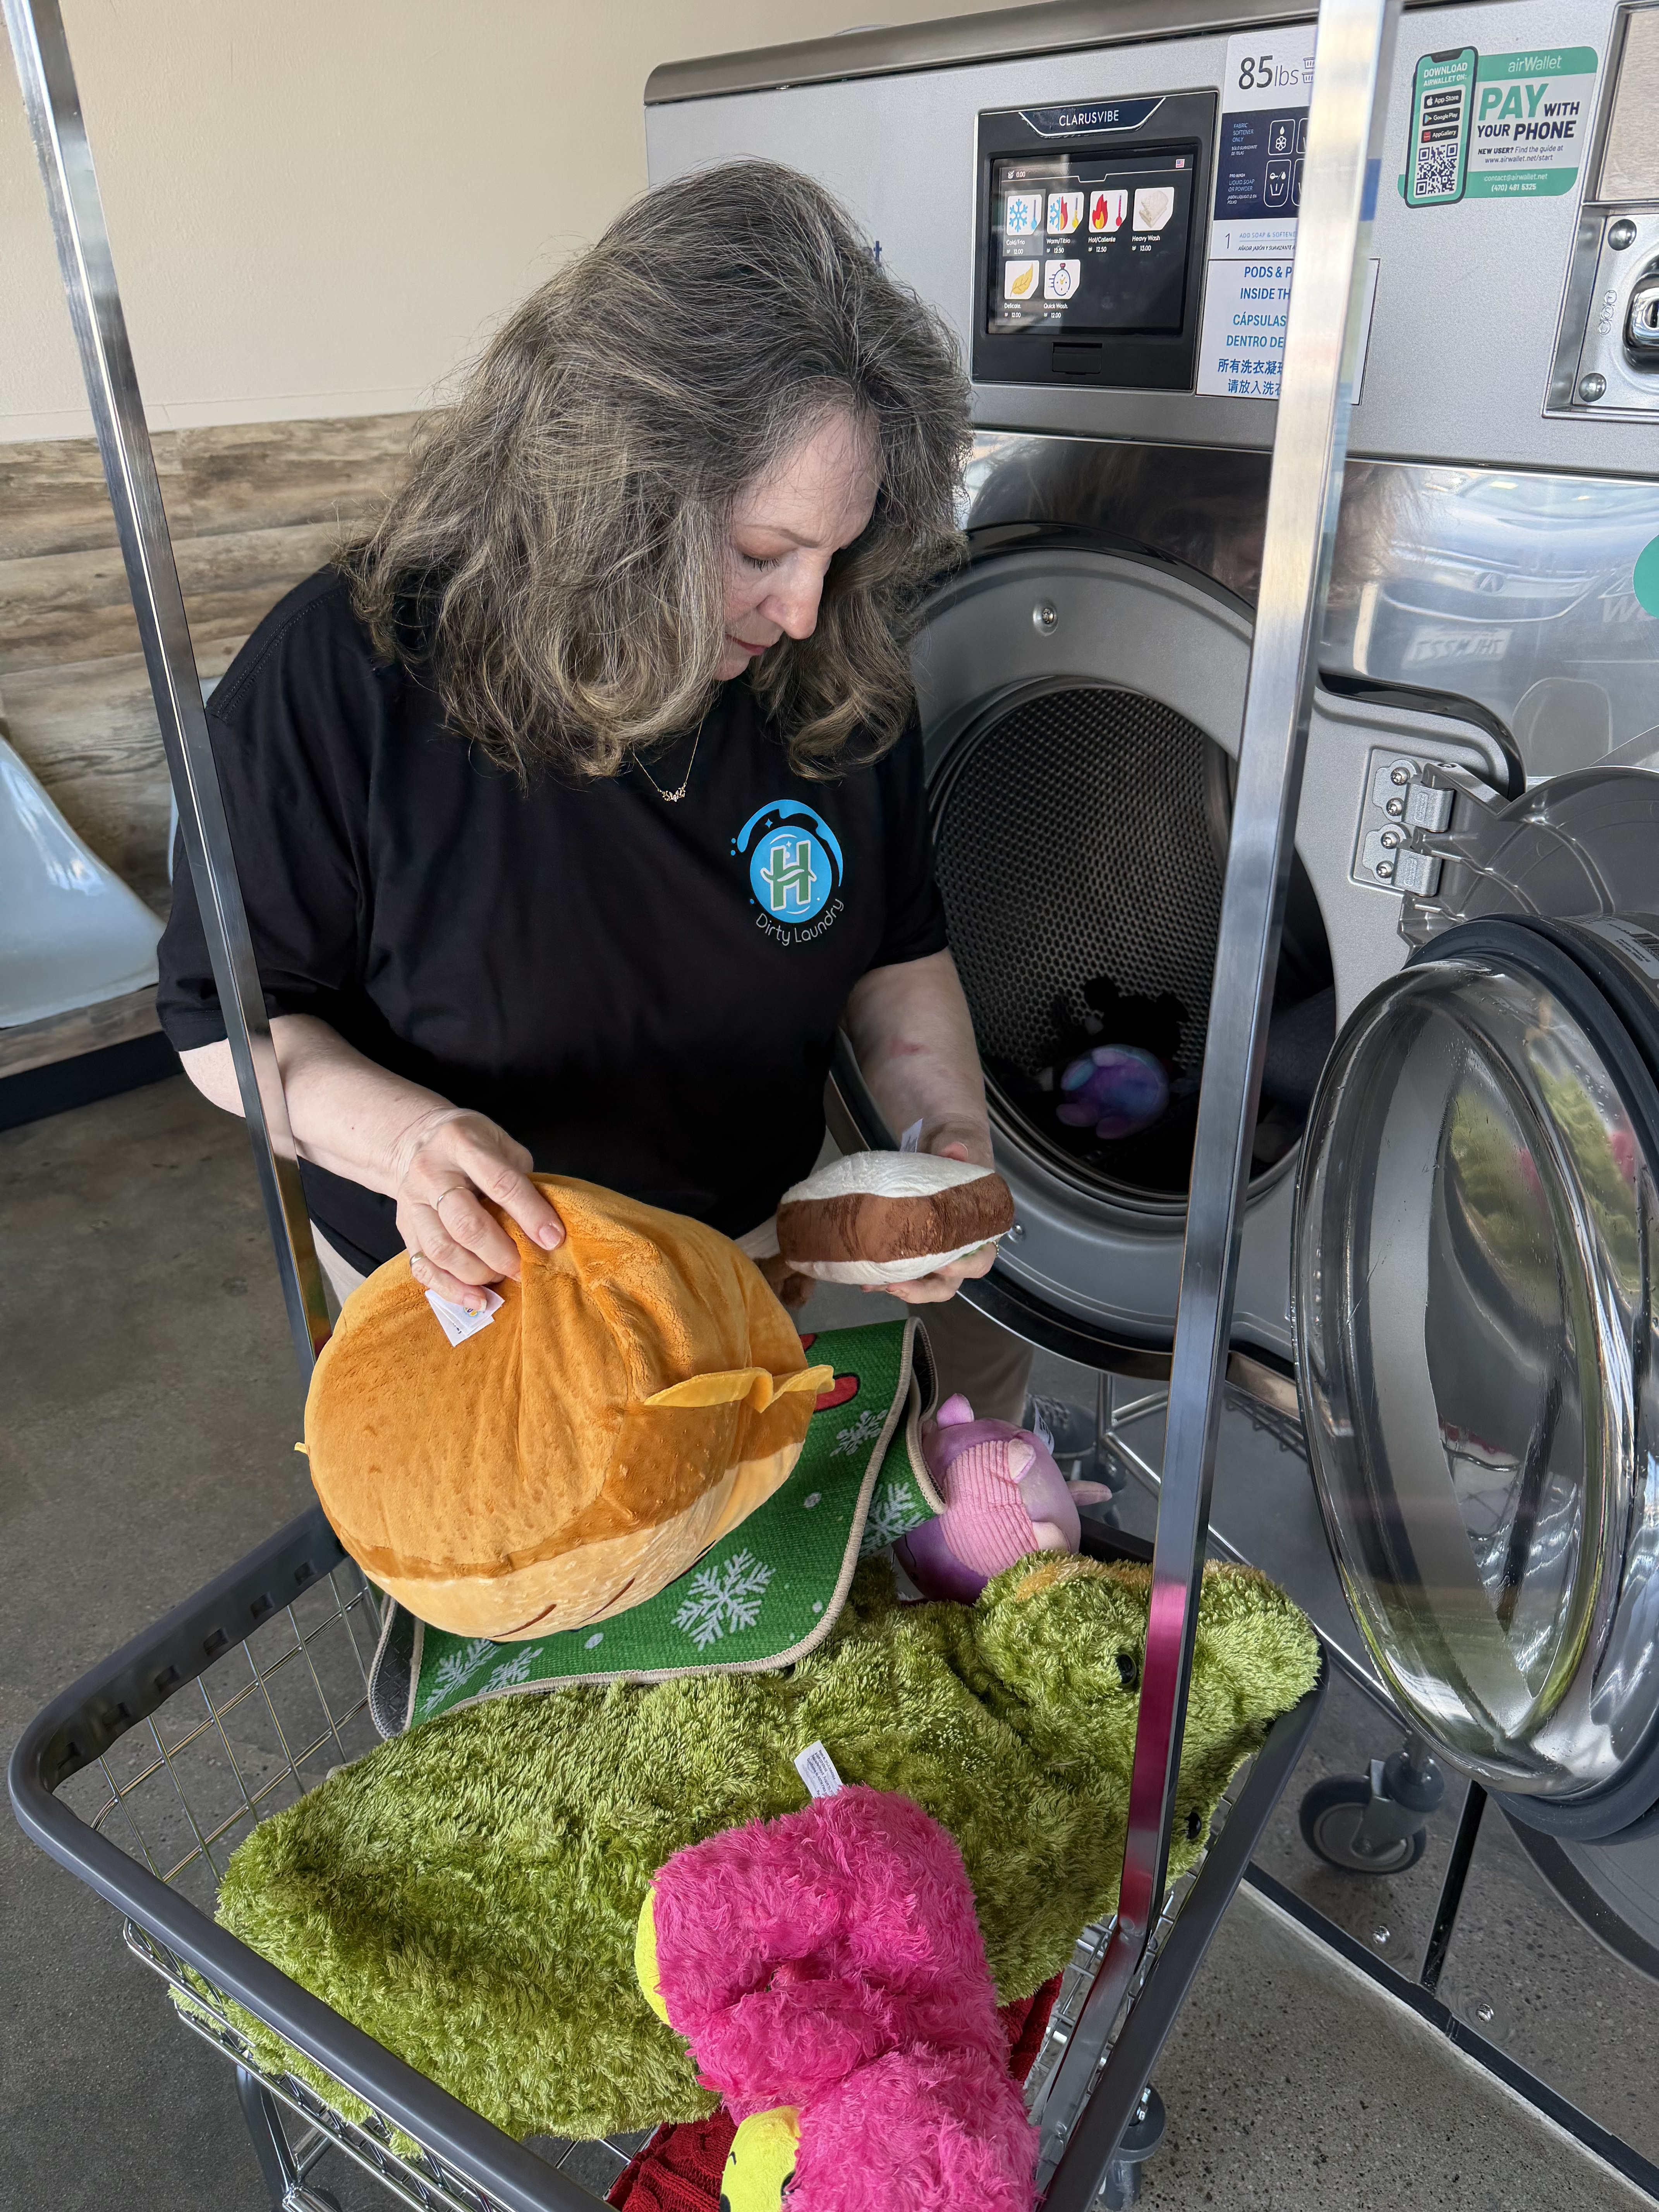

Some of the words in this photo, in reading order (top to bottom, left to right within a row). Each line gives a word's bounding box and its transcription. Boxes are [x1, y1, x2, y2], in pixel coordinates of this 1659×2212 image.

[1424, 62, 1468, 78] DOWNLOAD
[1508, 56, 1562, 72] airWallet
[1423, 75, 1456, 87] AIRWALLET
[1479, 83, 1549, 121] PAY
[1544, 101, 1580, 117] WITH
[1059, 110, 1119, 126] CLARUSVIBE
[1432, 130, 1456, 138] AppGallery
[1477, 124, 1510, 137] YOUR
[1513, 120, 1577, 141] PHONE
[1540, 145, 1556, 153] guide
[1485, 155, 1553, 163] www.airwallet.net/start
[1484, 173, 1547, 182] contact@airwallet.net
[1491, 184, 1507, 192] (470)
[1225, 233, 1230, 249] 1
[1244, 266, 1273, 278] PODS
[1275, 266, 1283, 278] &
[1285, 266, 1292, 278] P
[1240, 288, 1275, 299] INSIDE
[1278, 288, 1291, 299] TH
[1233, 311, 1286, 326] CÁPSULAS
[1226, 335, 1267, 347] DENTRO
[756, 912, 790, 946] Dirty
[794, 898, 844, 943] Laundry
